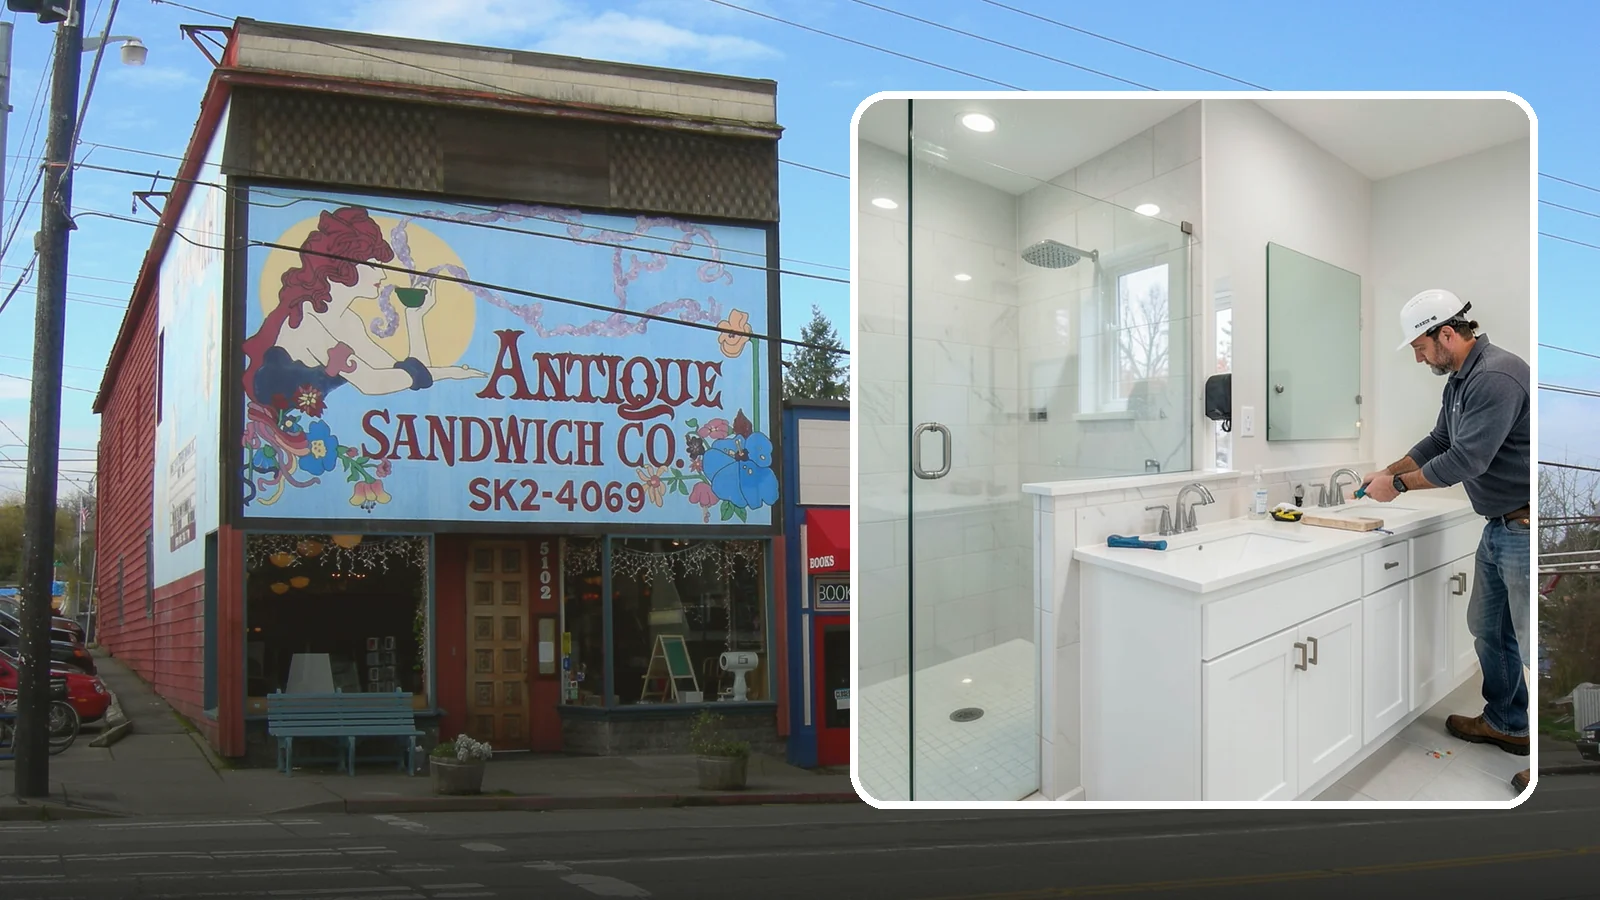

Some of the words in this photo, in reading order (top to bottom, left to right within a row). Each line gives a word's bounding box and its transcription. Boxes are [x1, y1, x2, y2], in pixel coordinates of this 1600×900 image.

[476, 329, 724, 420] ANTIQUE
[362, 409, 604, 467] SANDWICH
[617, 421, 685, 470] CO.
[469, 477, 646, 513] SK2-4069
[539, 542, 552, 599] 5102
[809, 555, 835, 568] BOOKS
